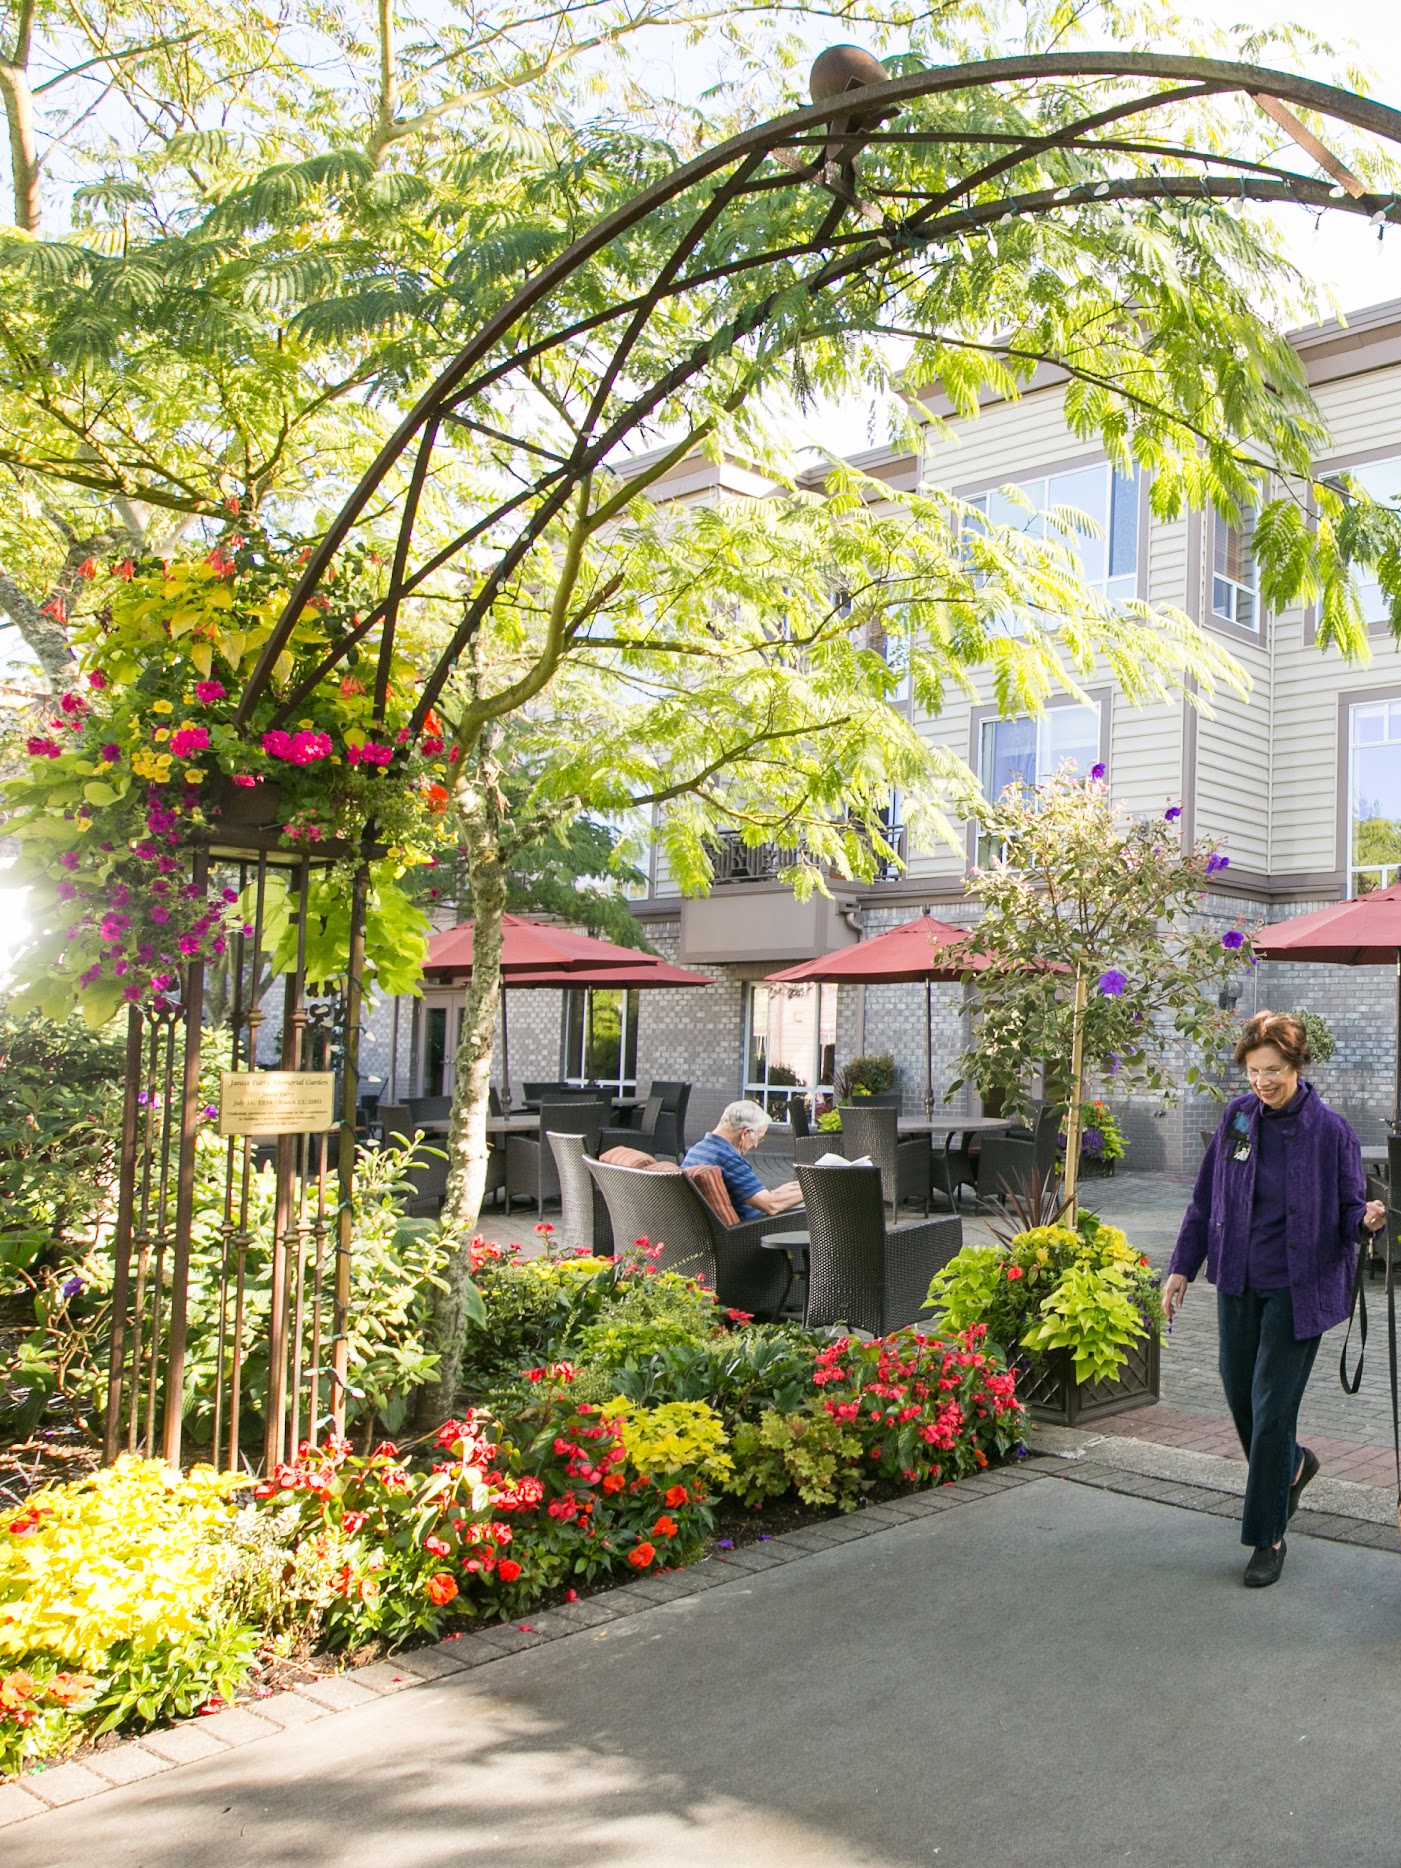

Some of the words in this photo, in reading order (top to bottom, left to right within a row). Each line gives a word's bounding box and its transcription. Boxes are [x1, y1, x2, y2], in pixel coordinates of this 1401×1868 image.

[273, 1078, 304, 1086] Memorial
[305, 1078, 328, 1086] Garden
[233, 1099, 244, 1107] July
